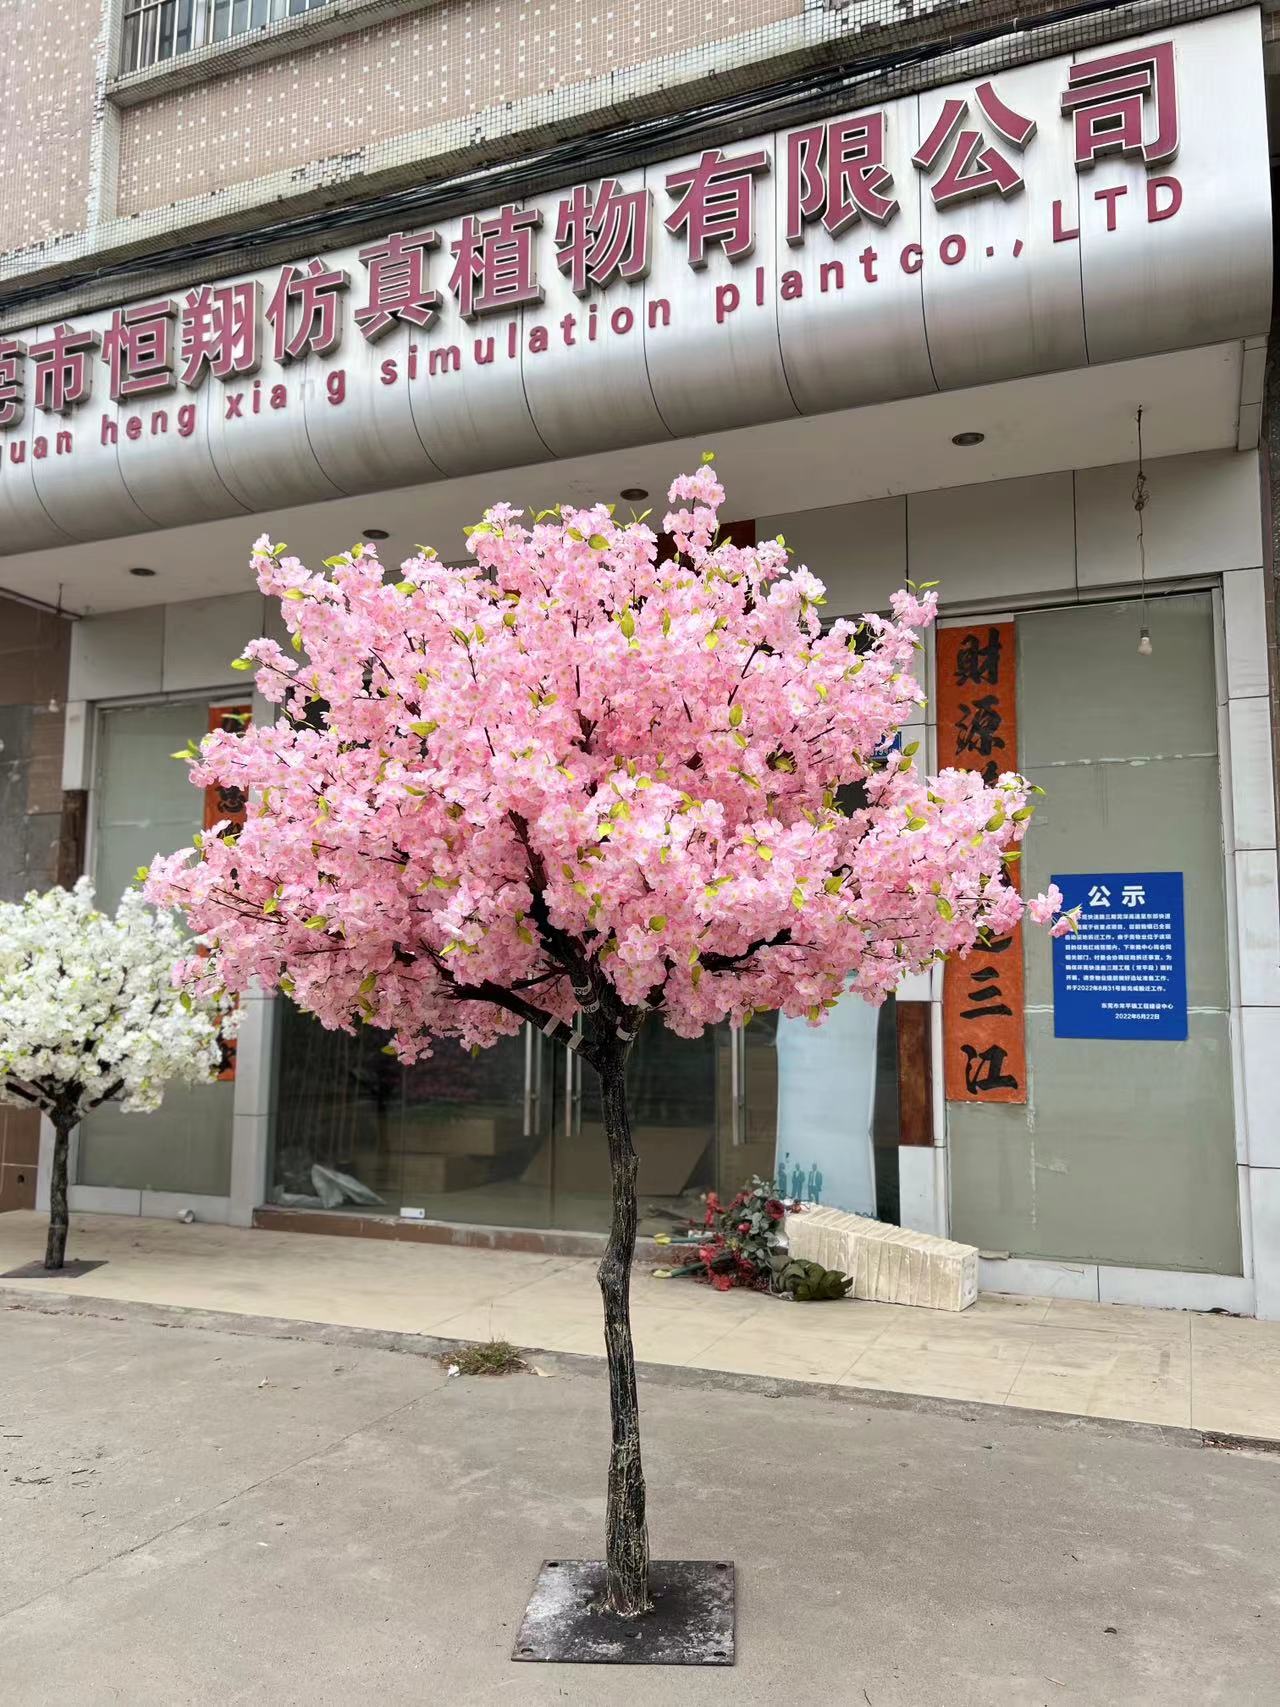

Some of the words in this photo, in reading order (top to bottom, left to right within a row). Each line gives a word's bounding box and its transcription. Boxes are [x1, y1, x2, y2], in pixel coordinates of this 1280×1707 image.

[0, 429, 73, 473] uan
[100, 402, 197, 446] heng
[380, 298, 672, 385] simulation
[1088, 885, 1146, 907] 公示
